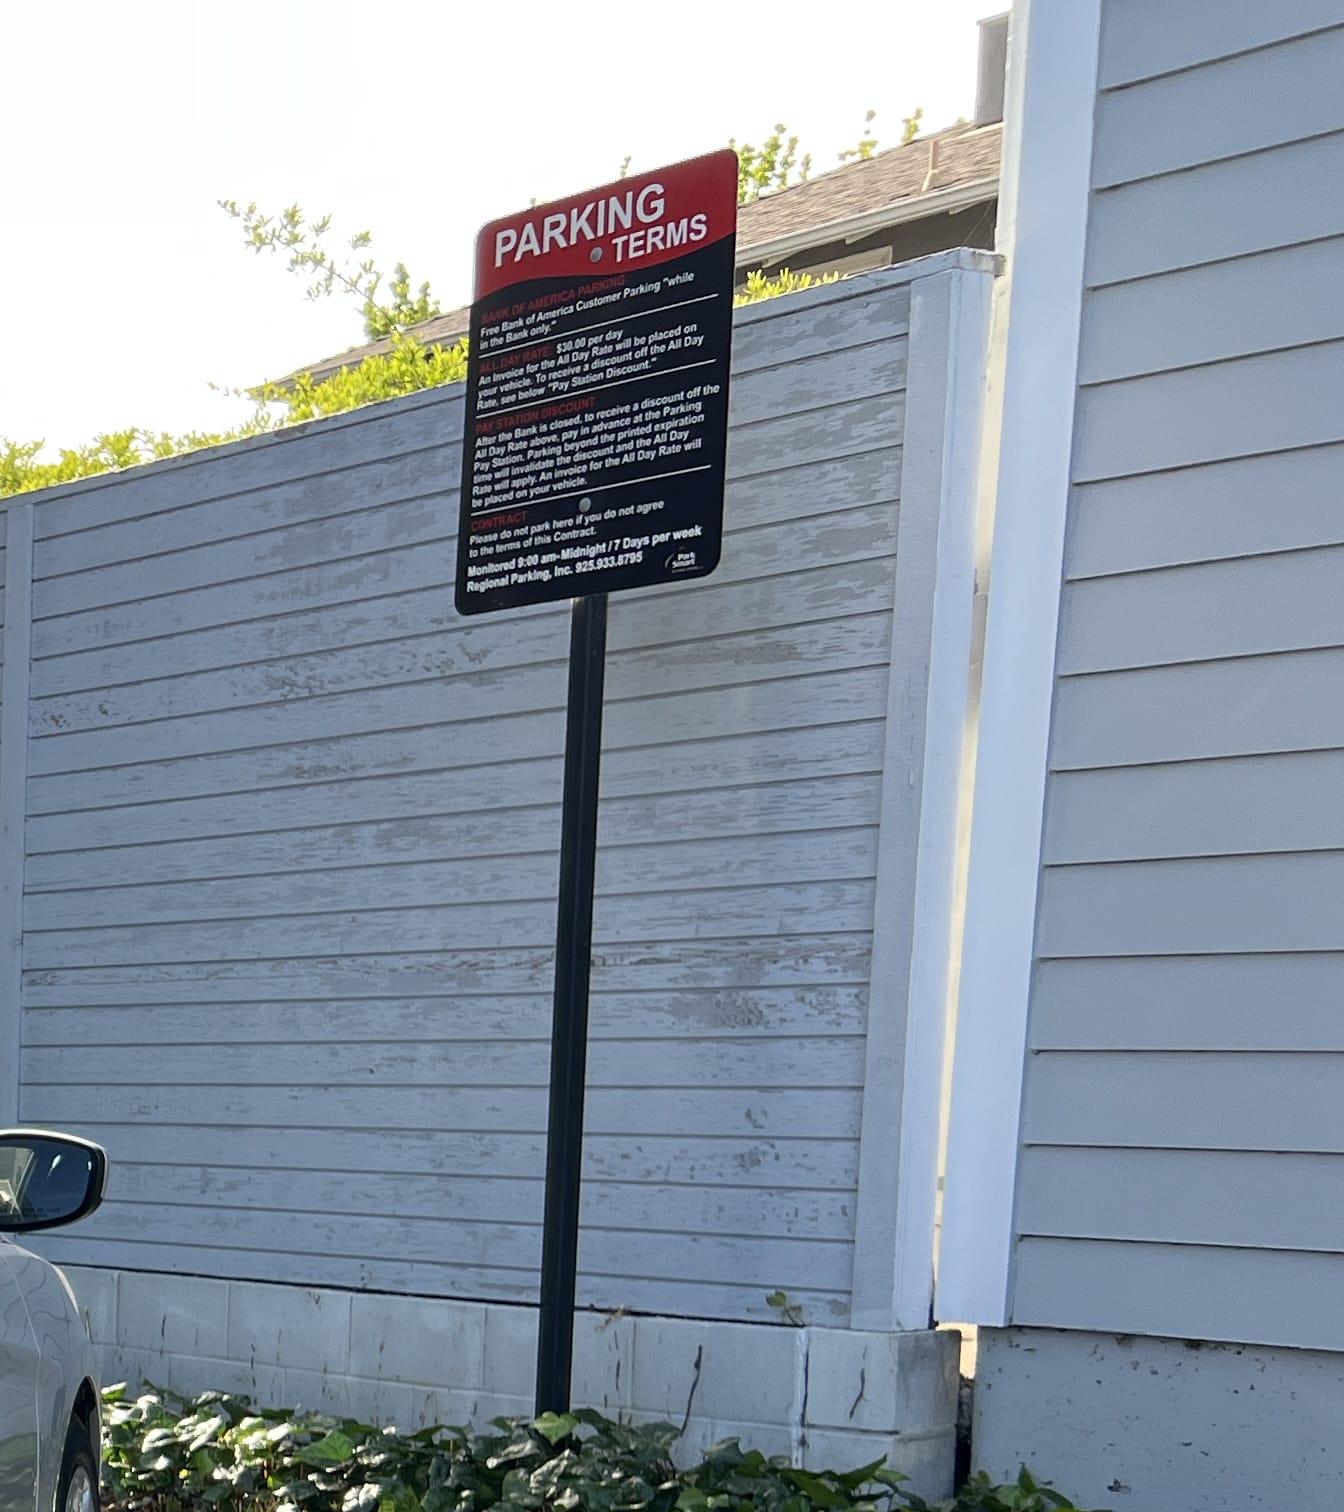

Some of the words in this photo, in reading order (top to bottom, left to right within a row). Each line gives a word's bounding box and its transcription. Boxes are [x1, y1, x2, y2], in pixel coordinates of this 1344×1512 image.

[494, 183, 665, 268] PARKING
[611, 213, 708, 263] TERMS
[480, 326, 499, 337] Free
[501, 317, 523, 331] Bank
[525, 313, 535, 325] of
[536, 305, 574, 322] America
[576, 292, 621, 311] Customer
[623, 281, 660, 298] Parking
[478, 376, 491, 386] An
[526, 363, 539, 373] for
[541, 359, 555, 370] the
[557, 353, 569, 366] All
[571, 350, 589, 362] Day
[591, 345, 613, 357] Rate
[615, 337, 631, 350] will
[633, 336, 646, 346] be
[648, 325, 681, 345] placed
[683, 324, 697, 334] on
[479, 340, 488, 349] in
[490, 337, 504, 347] the
[505, 328, 528, 343] Bank
[587, 334, 603, 348] per
[605, 329, 623, 341] day
[478, 386, 498, 400] your
[535, 372, 546, 383] To
[548, 365, 581, 380] receive
[591, 351, 632, 369] discount
[634, 346, 648, 358] off
[650, 344, 666, 355] the
[667, 338, 681, 350] All
[684, 335, 704, 347] Day
[500, 394, 516, 404] see
[518, 386, 545, 400] below
[571, 372, 604, 387] Station
[474, 448, 487, 459] All
[488, 446, 505, 456] Day
[507, 441, 528, 452] Rate
[561, 430, 578, 442] pay
[580, 426, 589, 435] in
[591, 417, 631, 433] advance
[633, 413, 643, 423] at
[645, 410, 661, 421] the
[663, 401, 702, 416] Parking
[475, 436, 496, 448] After
[498, 432, 512, 442] the
[514, 425, 537, 438] Bank
[539, 424, 547, 432] is
[584, 413, 594, 422] to
[596, 404, 630, 419] receive
[640, 391, 684, 409] discount
[686, 386, 701, 398] off
[703, 384, 720, 395] the
[472, 485, 492, 495] Rate
[494, 479, 509, 490] will
[539, 471, 552, 481] An
[589, 460, 603, 471] for
[605, 457, 620, 467] the
[621, 452, 635, 464] All
[637, 450, 656, 460] Day
[658, 444, 681, 456] Rate
[683, 438, 701, 450] will
[473, 461, 490, 472] Pay
[527, 445, 562, 459] Parking
[564, 435, 598, 451] beyond
[600, 433, 615, 443] the
[617, 423, 652, 441] printed
[654, 414, 704, 431] expiration
[473, 473, 492, 484] time
[494, 467, 509, 478] will
[511, 459, 554, 475] invalidate
[556, 455, 571, 465] the
[573, 445, 614, 462] discount
[615, 439, 634, 453] and
[636, 438, 651, 448] the
[653, 432, 667, 444] All
[669, 430, 689, 441] Day
[471, 498, 483, 507] be
[484, 490, 514, 507] placed
[515, 489, 527, 498] on
[529, 484, 550, 498] your
[469, 533, 498, 545] Please
[500, 529, 512, 539] do
[513, 526, 528, 536] not
[530, 521, 550, 535] park
[552, 518, 573, 529] here
[575, 514, 583, 524] if
[584, 513, 601, 526] you
[603, 509, 616, 519] do
[618, 505, 634, 516] not
[636, 500, 664, 514] agree
[469, 549, 478, 558] to
[480, 546, 494, 556] the
[495, 541, 521, 553] terms
[522, 537, 532, 547] of
[534, 534, 551, 545] this
[467, 558, 516, 577] Monitored
[517, 554, 538, 568] 9:00
[614, 539, 620, 550] 7
[622, 536, 649, 549] Days
[651, 532, 671, 546] per
[672, 525, 702, 539] week
[466, 574, 509, 592] Regional
